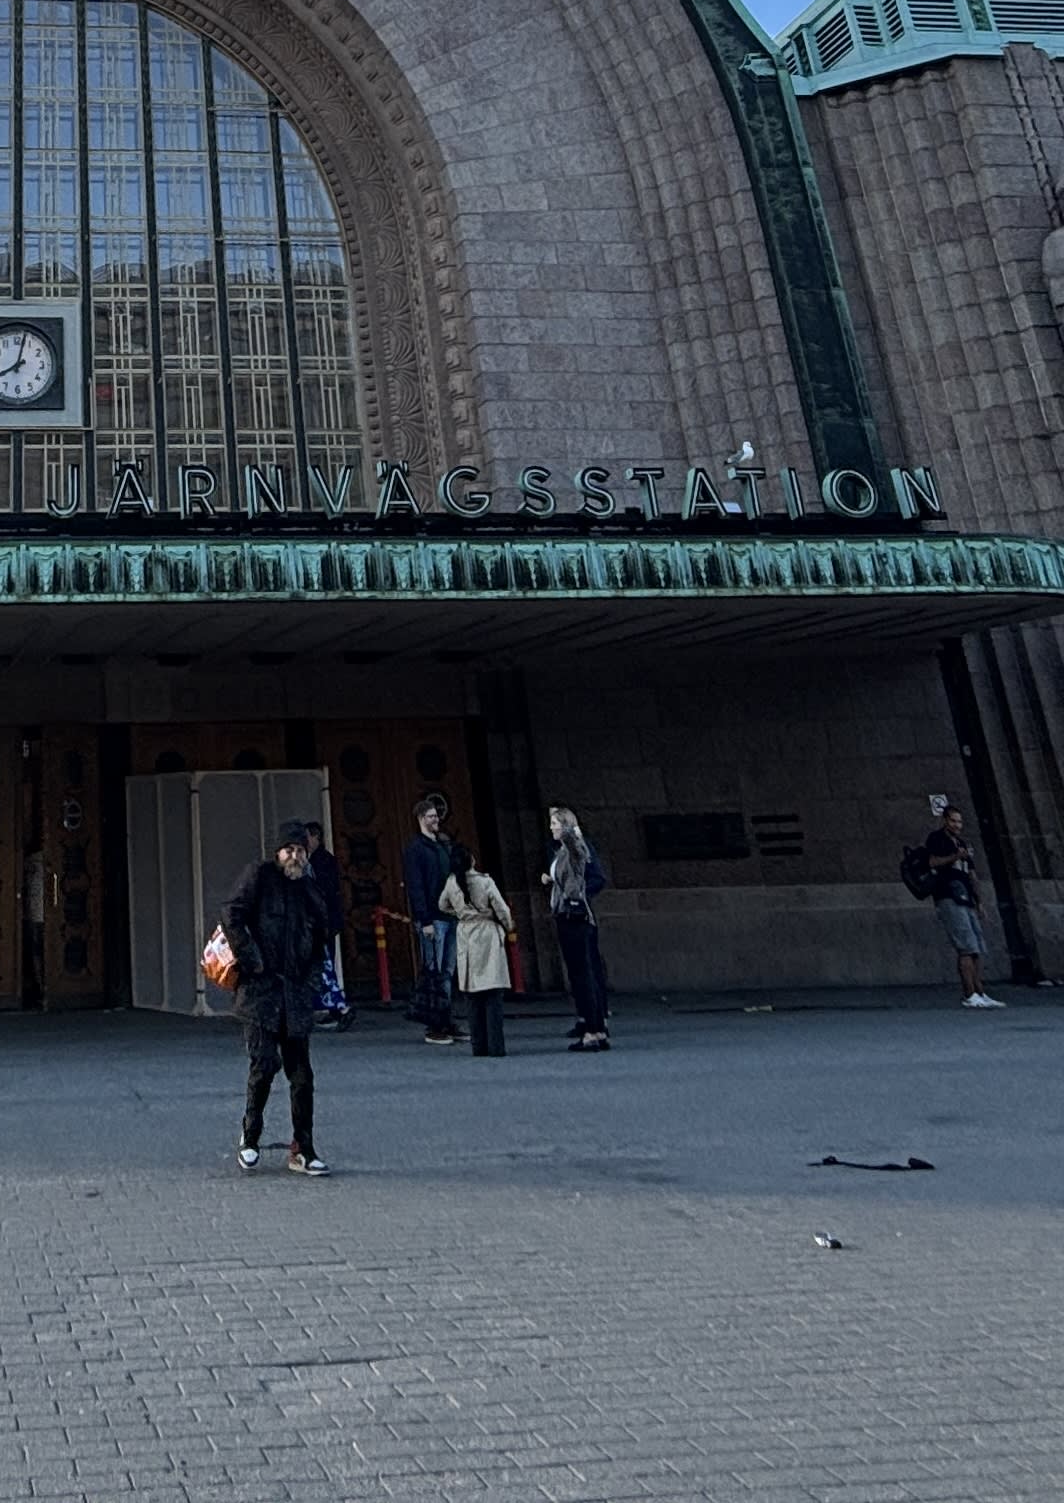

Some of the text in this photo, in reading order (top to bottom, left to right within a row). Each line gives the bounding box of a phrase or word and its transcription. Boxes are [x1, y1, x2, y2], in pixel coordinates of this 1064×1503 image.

[2, 340, 9, 348] 11
[13, 336, 21, 345] 12
[35, 349, 41, 357] 2
[39, 361, 45, 369] 3
[35, 373, 41, 381] 4
[2, 382, 8, 391] 7
[15, 385, 20, 394] 6
[27, 382, 33, 391] 5
[46, 458, 942, 522] JÄRNVÄGSSTATION
